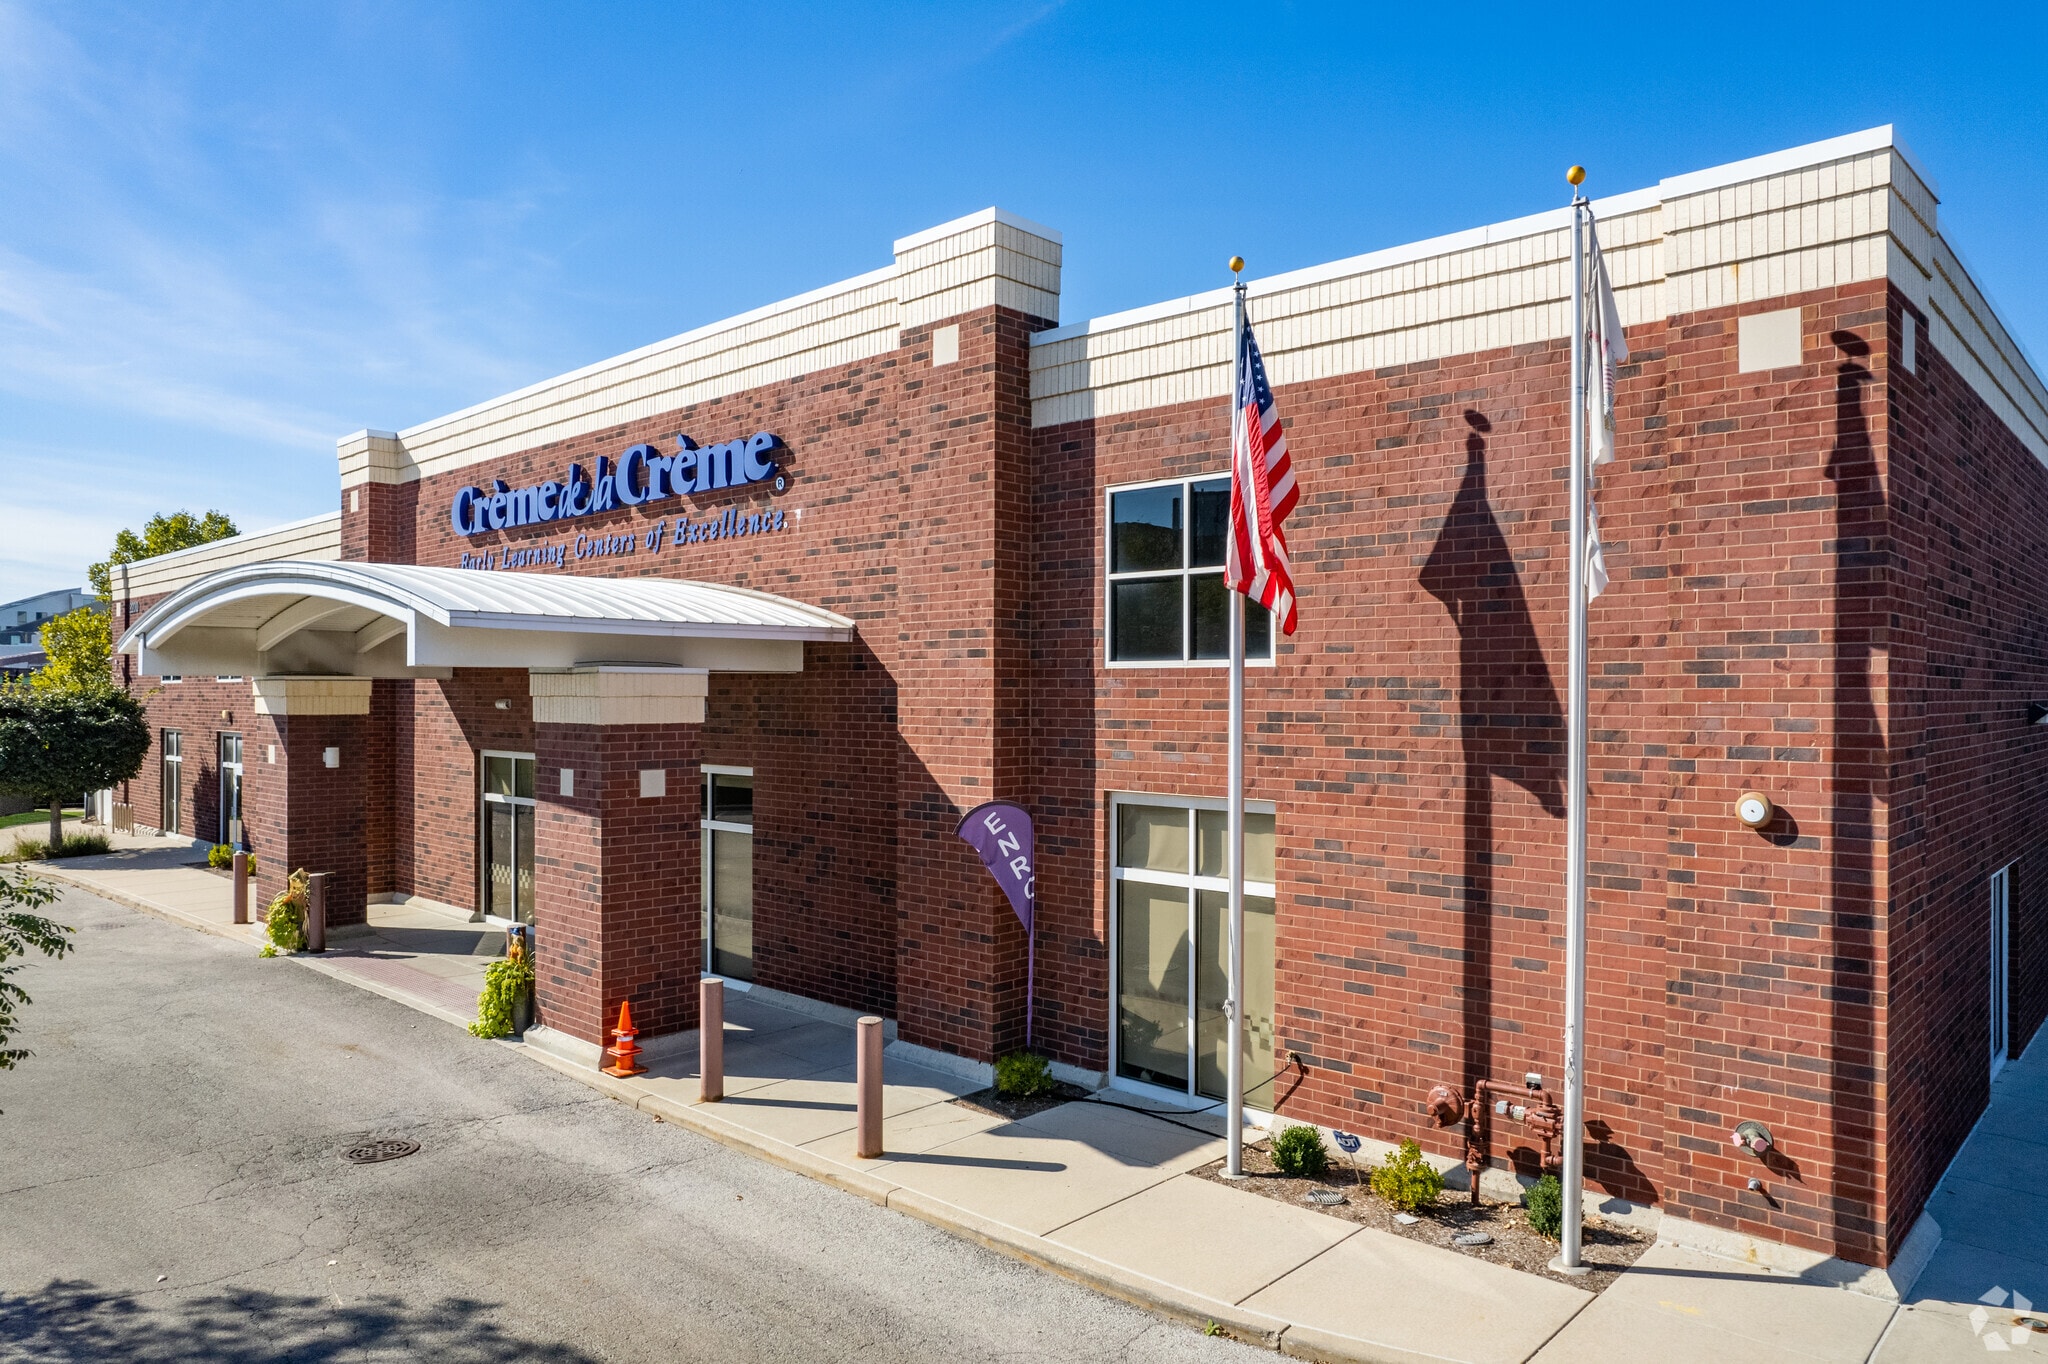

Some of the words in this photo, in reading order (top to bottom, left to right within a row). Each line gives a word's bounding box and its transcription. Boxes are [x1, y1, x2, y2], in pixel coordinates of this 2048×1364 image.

[452, 480, 558, 537] Crème
[558, 463, 592, 519] de
[590, 455, 615, 512] la
[615, 431, 774, 505] Crème
[501, 540, 567, 569] Learning
[574, 532, 636, 559] Centers
[645, 520, 666, 554] of
[672, 508, 784, 545] Excellence
